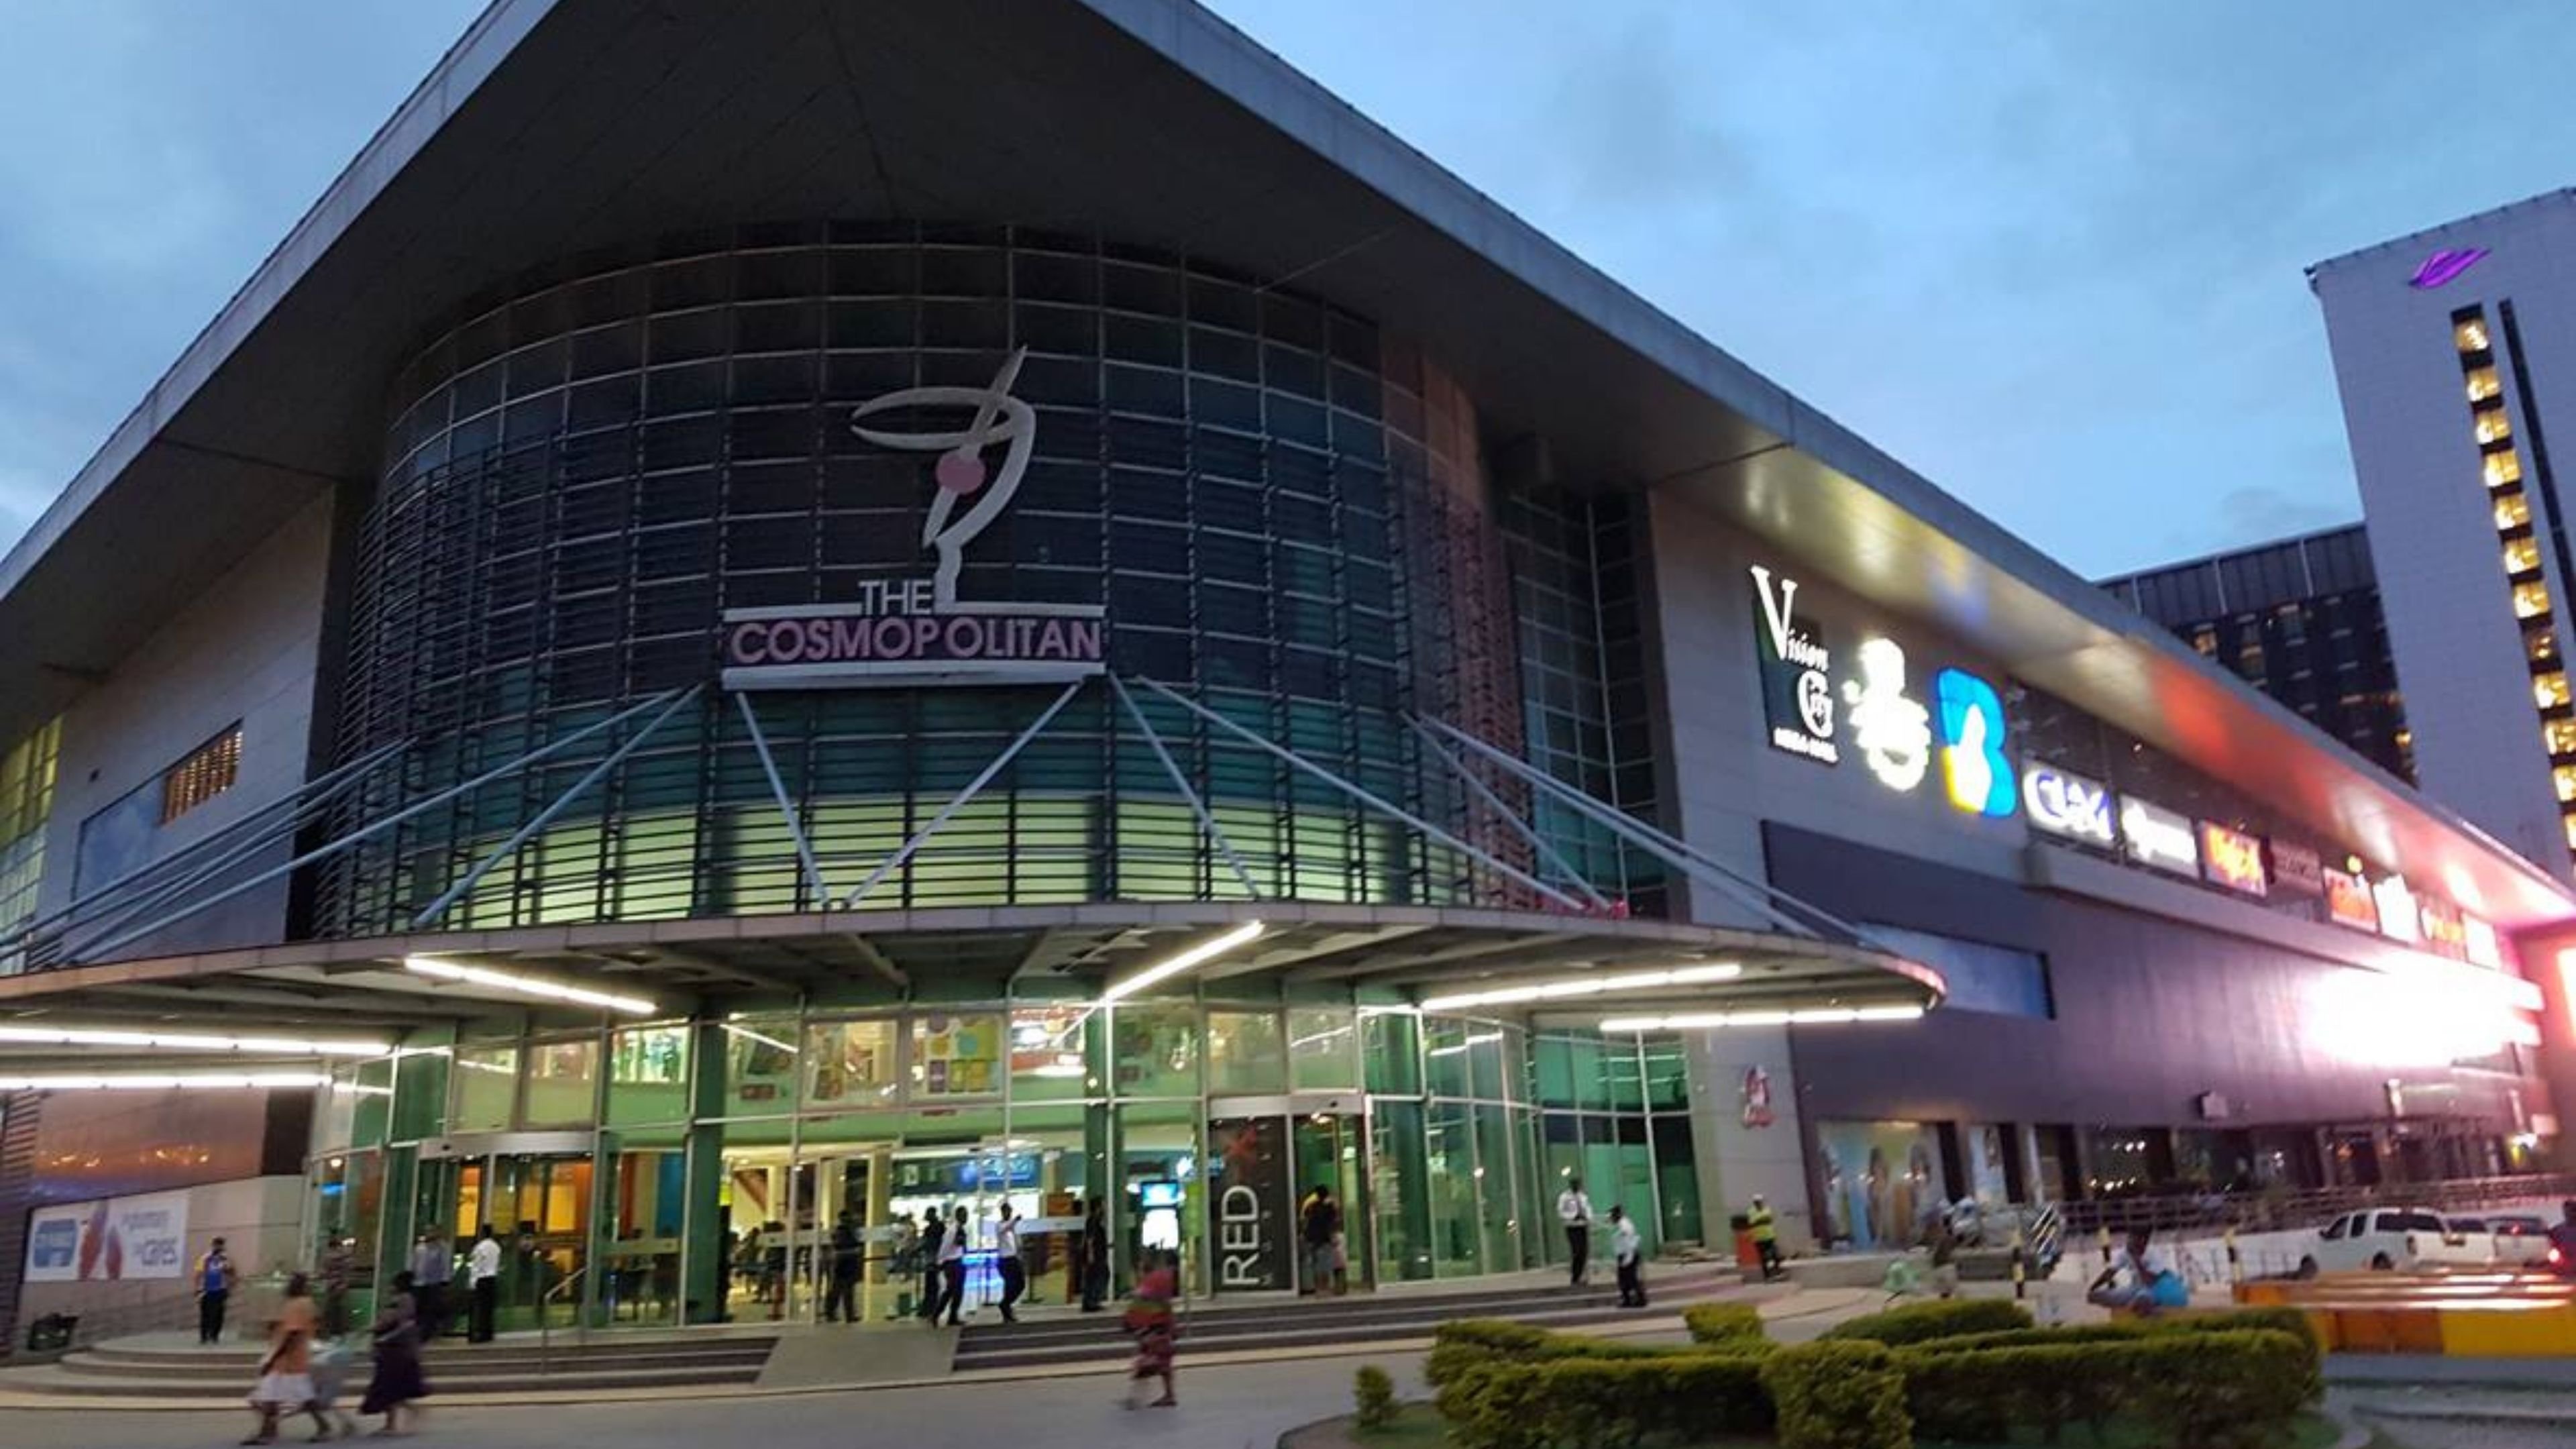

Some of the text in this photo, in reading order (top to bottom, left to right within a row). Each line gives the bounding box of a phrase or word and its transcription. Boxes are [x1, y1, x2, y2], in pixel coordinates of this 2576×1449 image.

[860, 580, 932, 615] THE
[1751, 566, 1829, 670] Vision
[731, 617, 1101, 663] COSMOPOLITAN
[1221, 1185, 1260, 1285] RED
